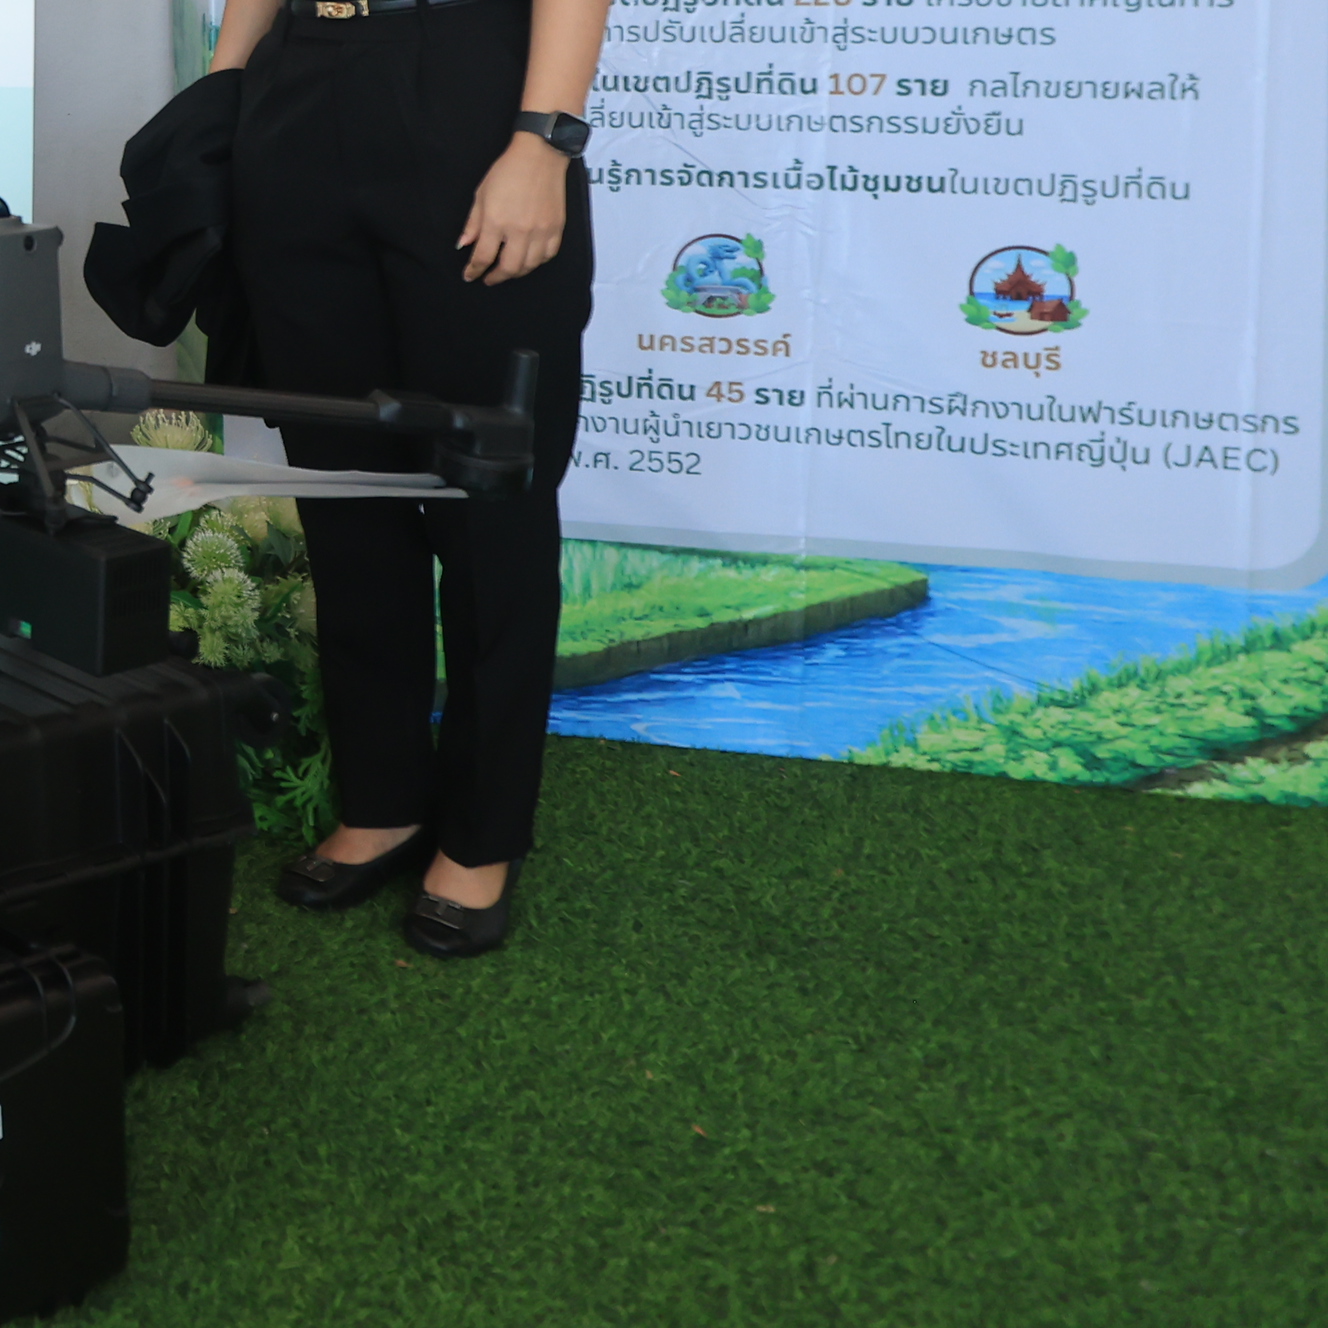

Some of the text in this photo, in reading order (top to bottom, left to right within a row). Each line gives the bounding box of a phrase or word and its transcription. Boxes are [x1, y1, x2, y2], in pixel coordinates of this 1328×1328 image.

[828, 71, 1200, 103] 107 ราย กลไกขยายผลให้
[637, 333, 1063, 379] นครสวรรค์ ชลบุรี
[705, 381, 745, 404] 45
[754, 386, 805, 407] ราย
[628, 449, 702, 476] 2552
[1162, 443, 1281, 477] (JAEC)
